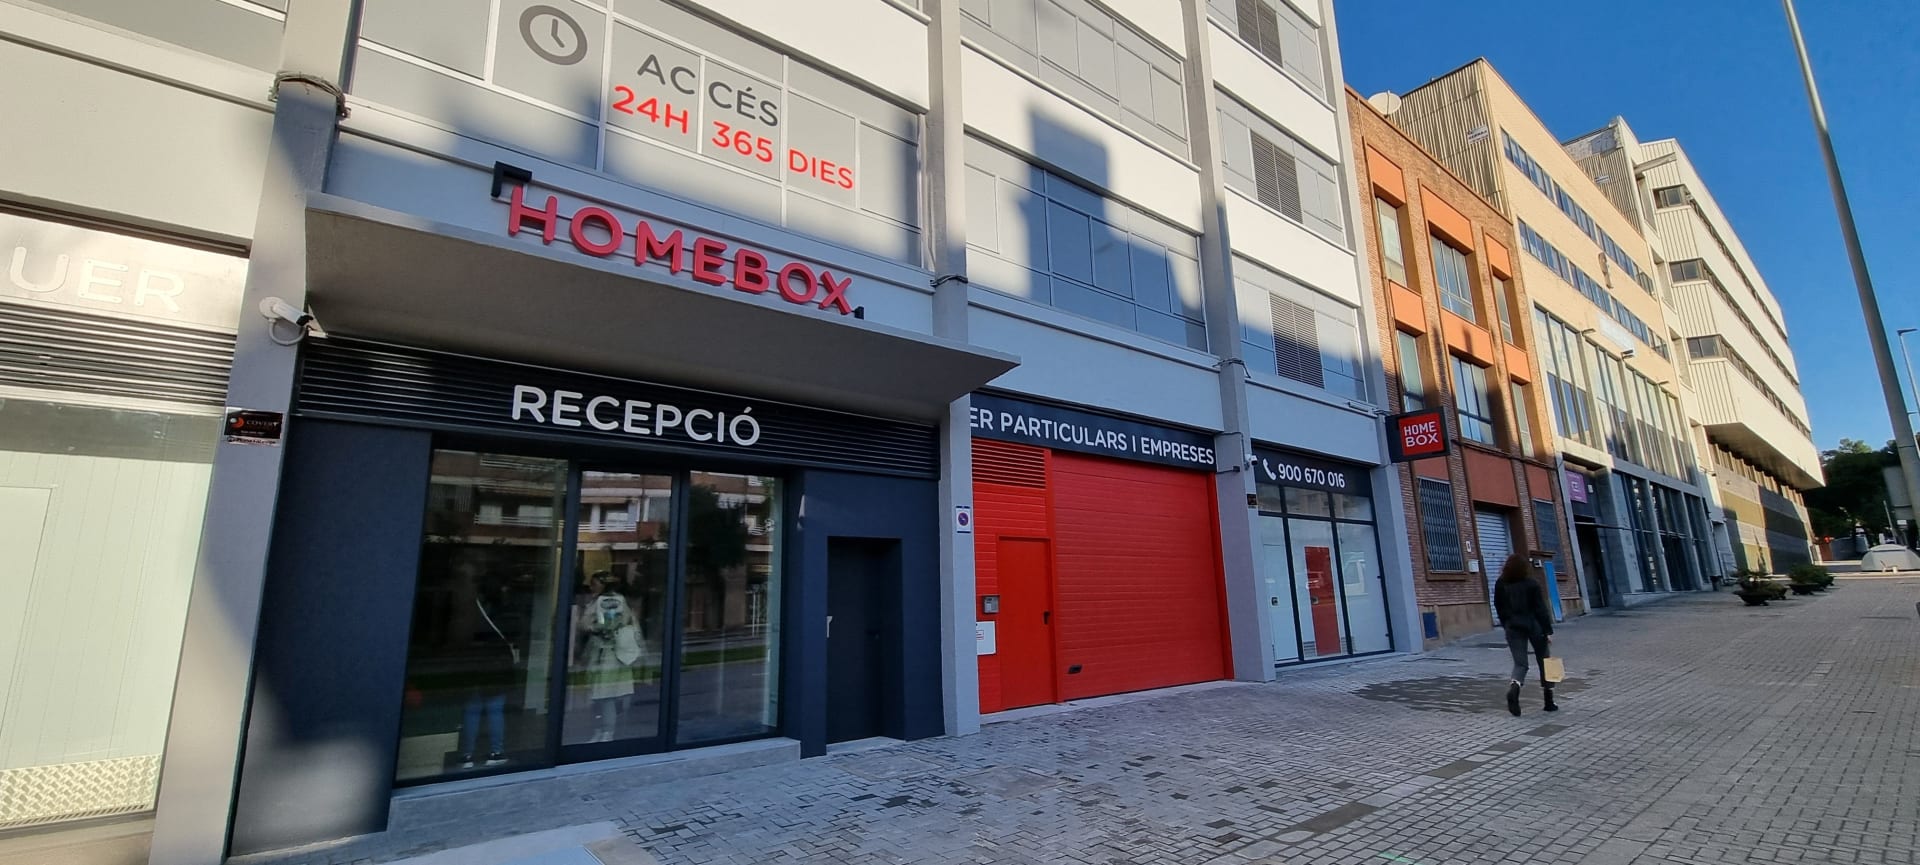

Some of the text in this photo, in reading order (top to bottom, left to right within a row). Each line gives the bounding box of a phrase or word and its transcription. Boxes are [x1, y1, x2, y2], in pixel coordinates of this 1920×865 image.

[612, 85, 853, 190] 24H 365 DIES
[508, 184, 854, 315] HOMEBOX
[512, 385, 760, 446] RECEPCIÓ
[1000, 412, 1127, 451] PARTICULARS
[1132, 435, 1137, 452] I
[1141, 437, 1215, 465] EMPRESES
[1404, 421, 1437, 436] HOME
[1406, 433, 1439, 447] BOX
[1278, 463, 1347, 489] 900 670 016
